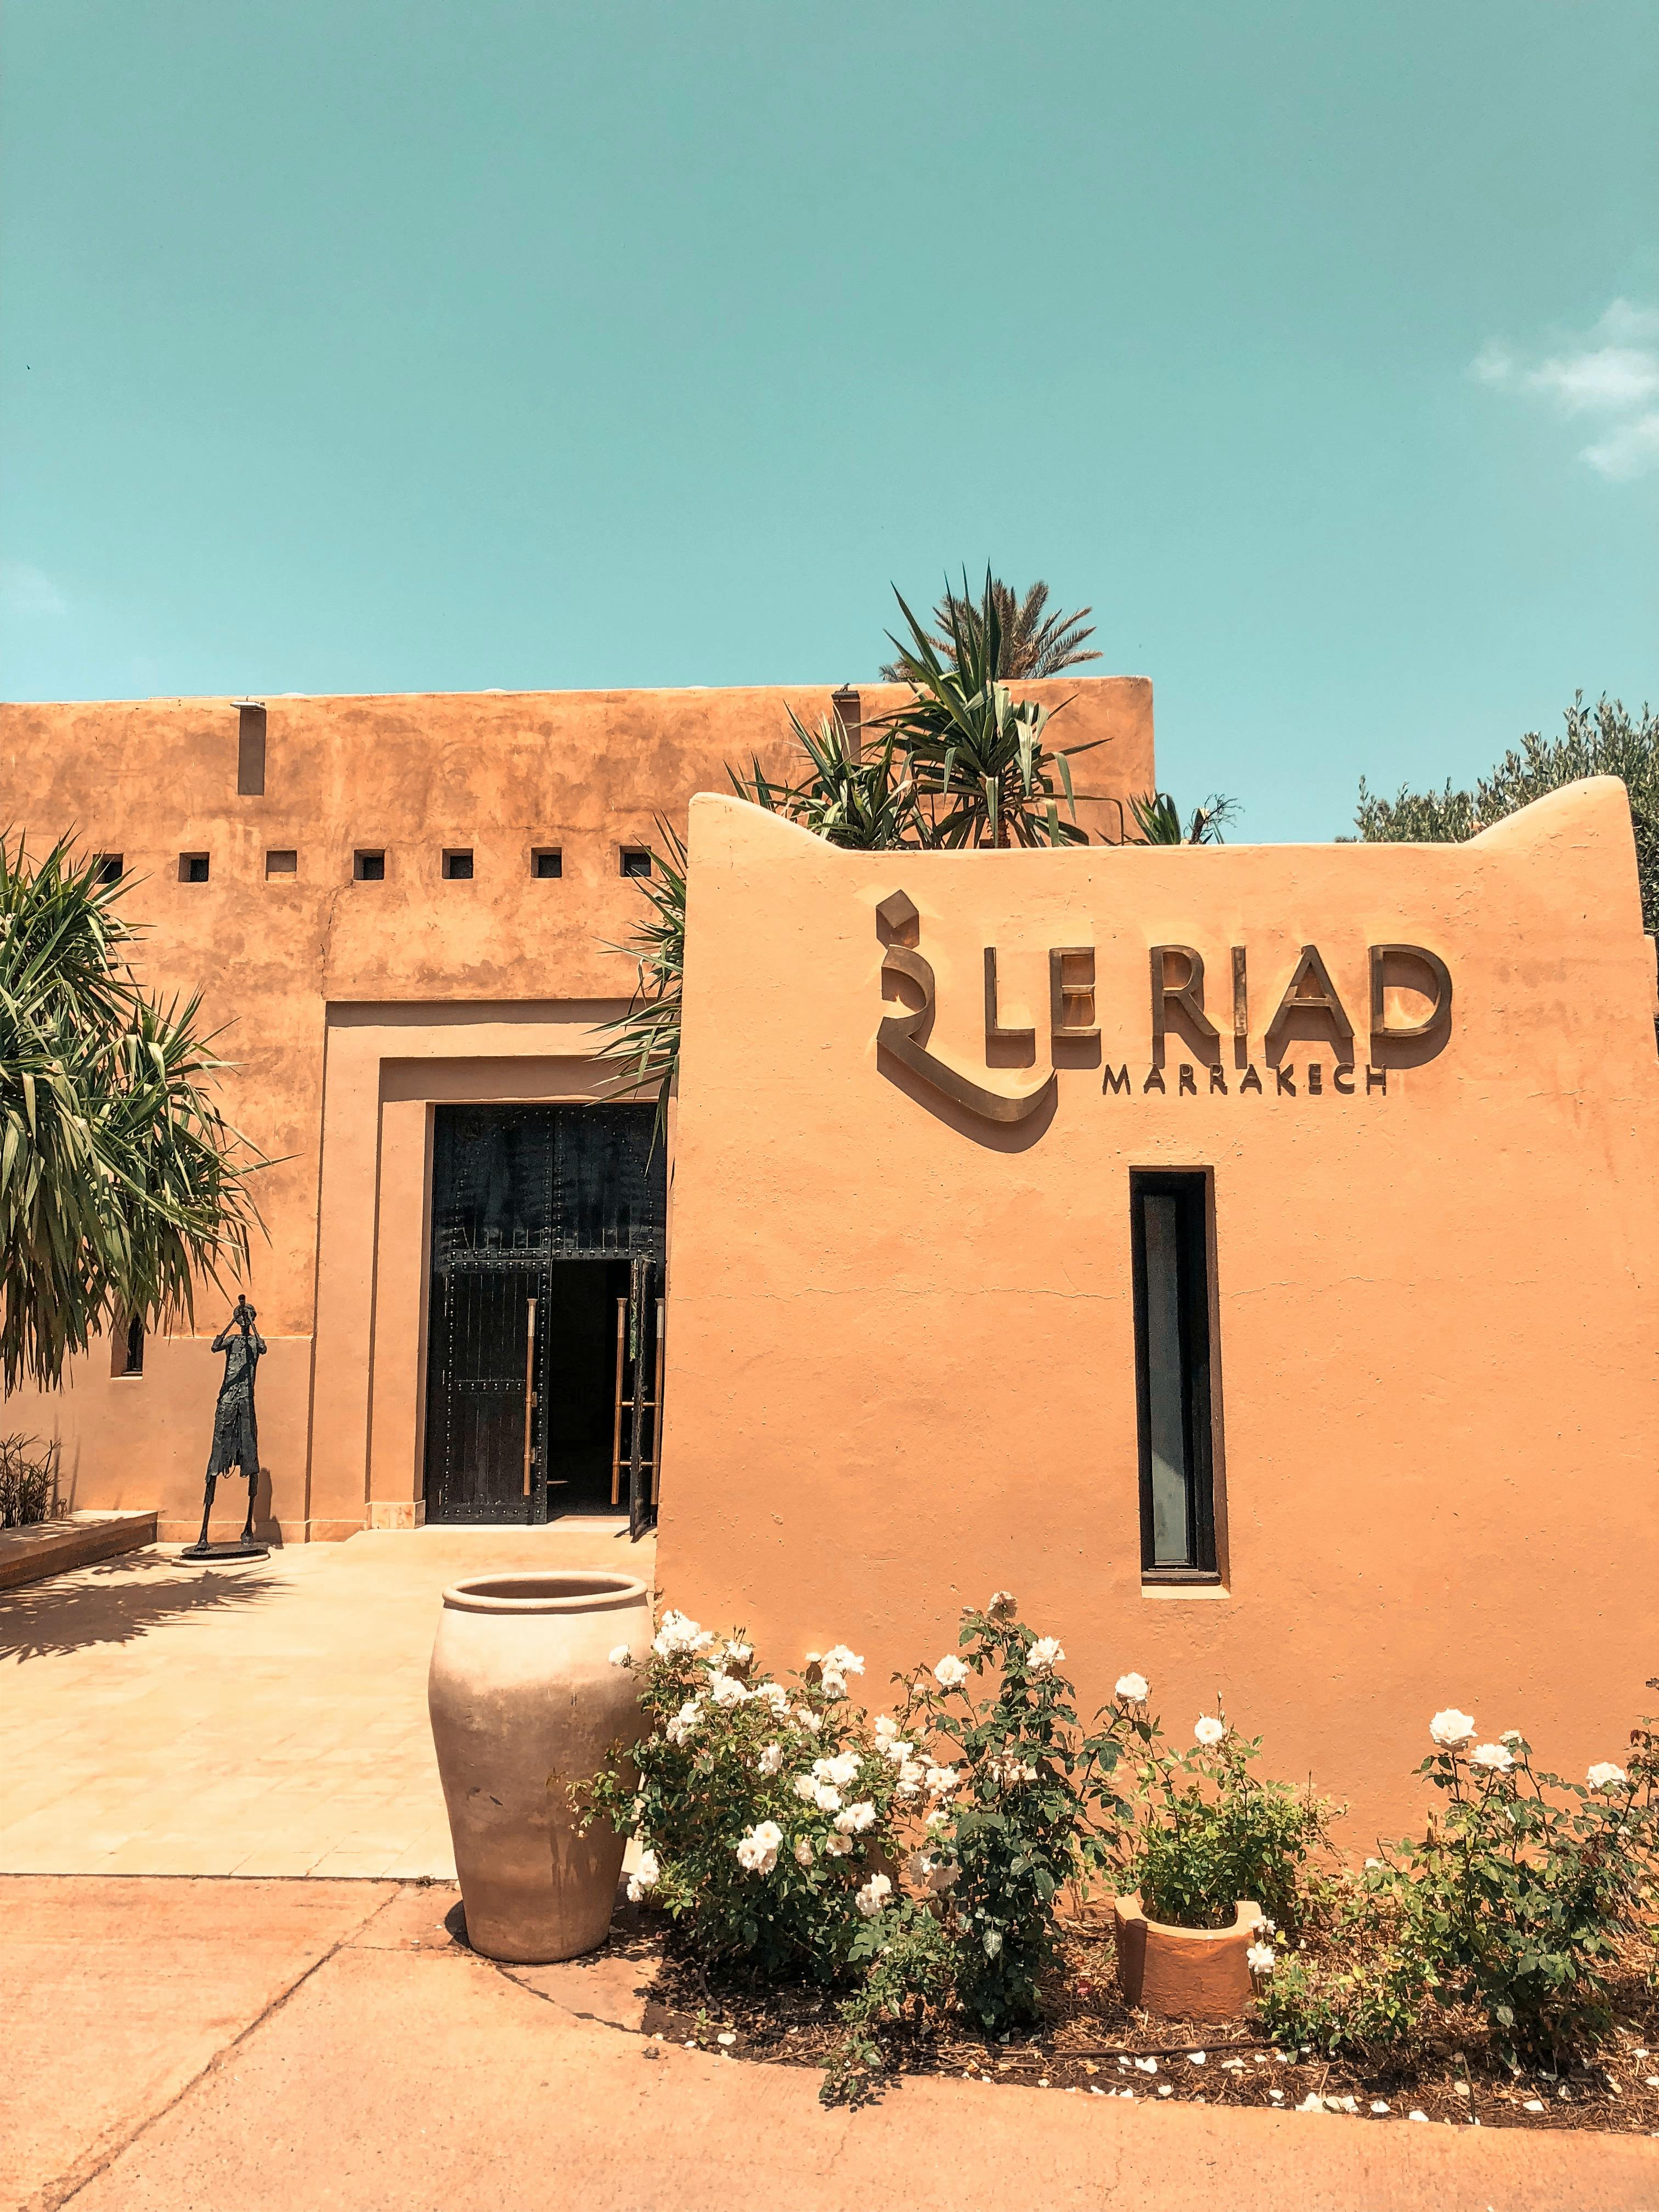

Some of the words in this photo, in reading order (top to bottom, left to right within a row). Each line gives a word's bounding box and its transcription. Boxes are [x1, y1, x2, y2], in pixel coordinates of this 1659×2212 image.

[984, 946, 1102, 1038] LE
[1149, 944, 1453, 1039] RIAD
[1103, 1063, 1386, 1096] MARRAKECH
